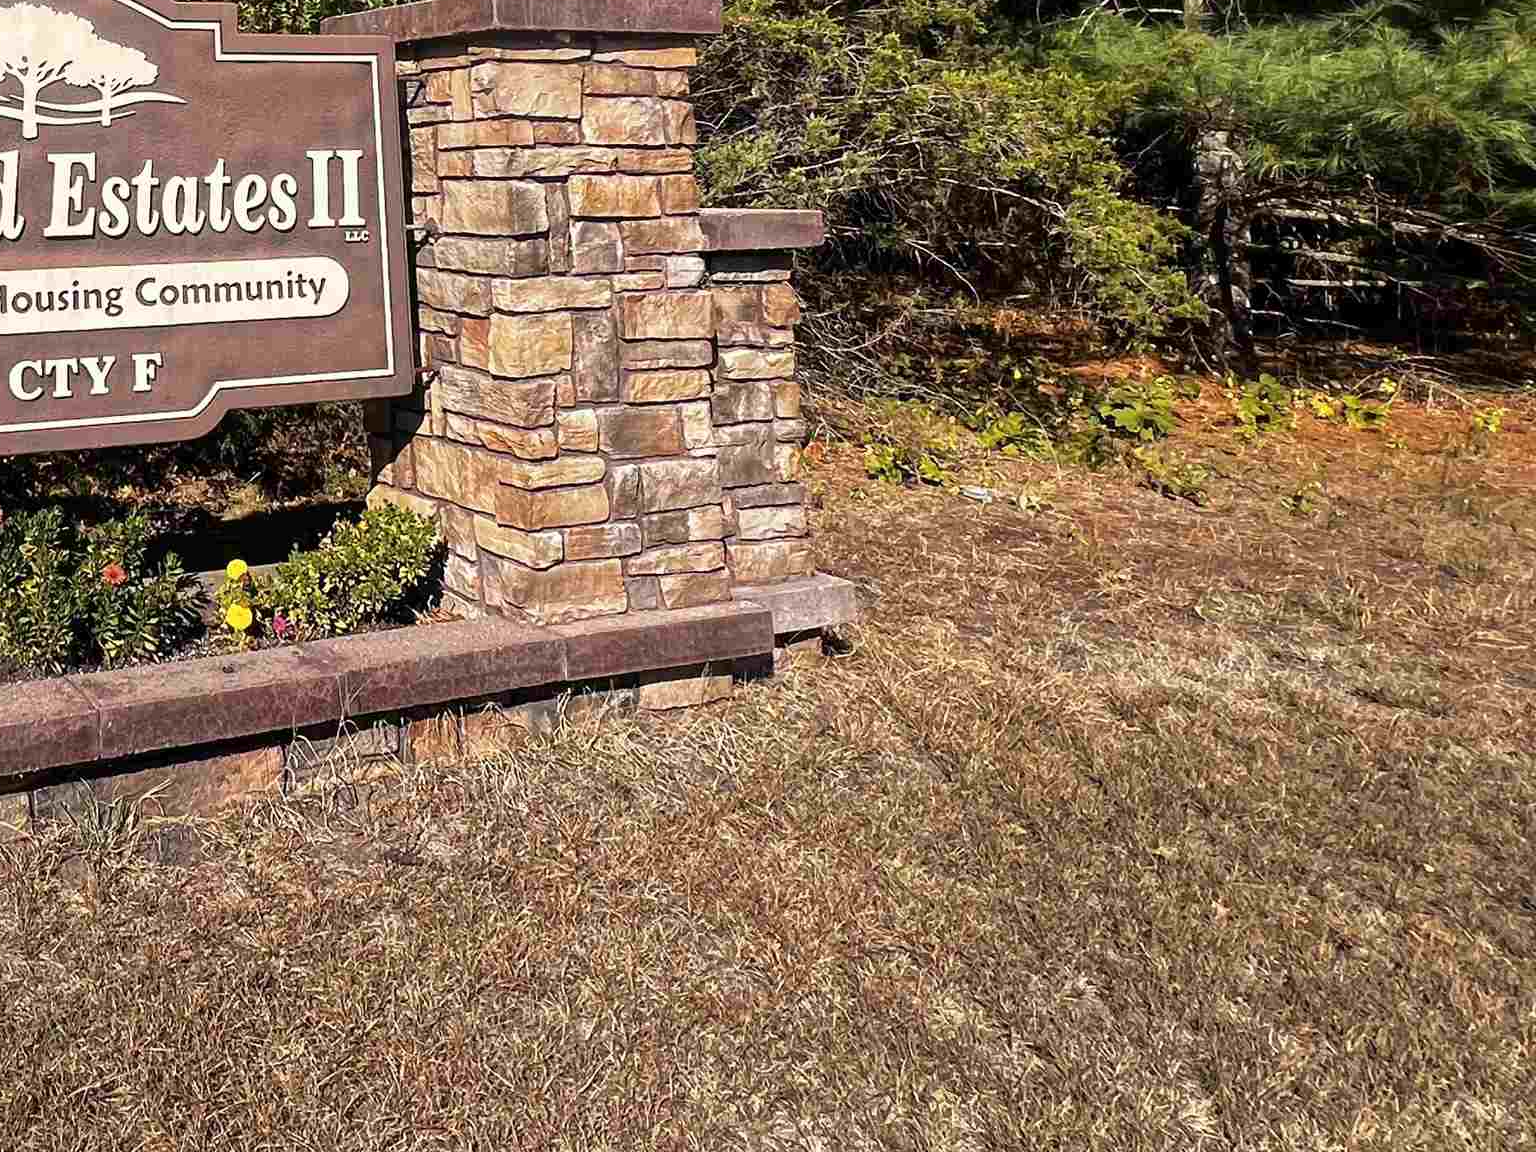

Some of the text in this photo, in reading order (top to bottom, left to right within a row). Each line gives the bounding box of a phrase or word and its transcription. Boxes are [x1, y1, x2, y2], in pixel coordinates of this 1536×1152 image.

[43, 152, 298, 238] Estates
[305, 149, 366, 227] II
[345, 230, 369, 242] LLC
[135, 271, 326, 306] Community
[9, 355, 117, 400] CTY
[131, 352, 163, 392] F
